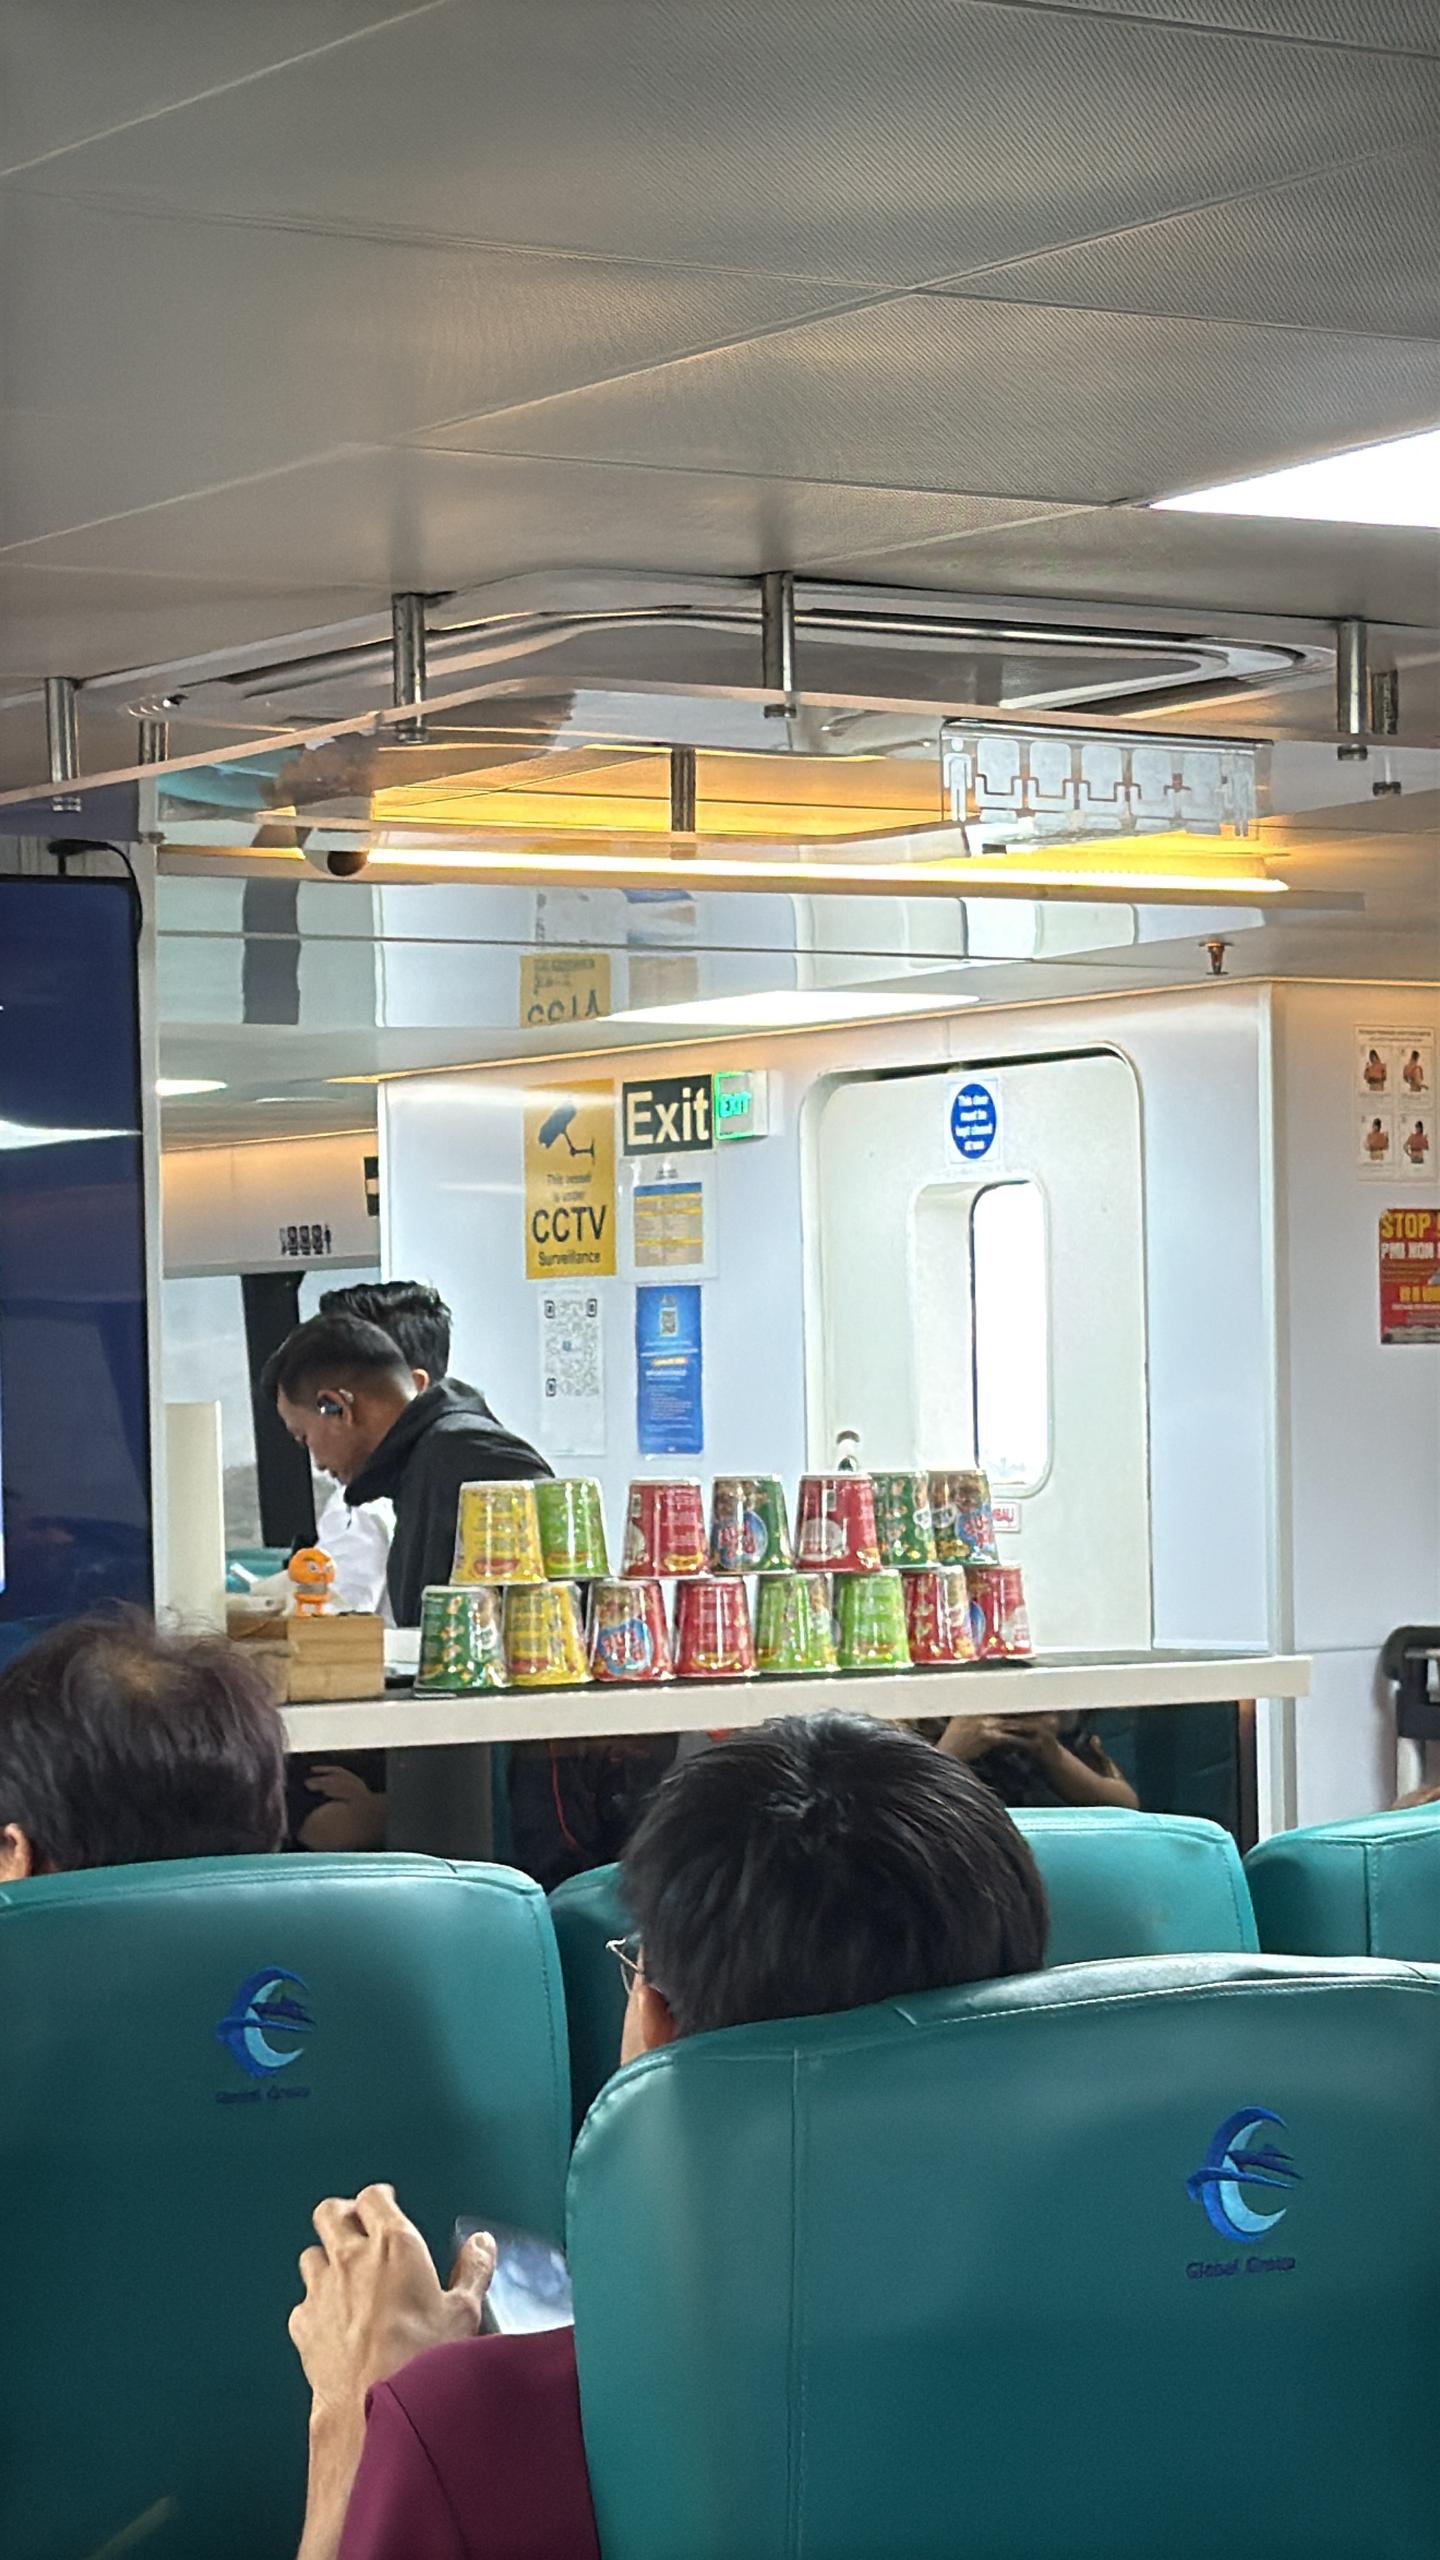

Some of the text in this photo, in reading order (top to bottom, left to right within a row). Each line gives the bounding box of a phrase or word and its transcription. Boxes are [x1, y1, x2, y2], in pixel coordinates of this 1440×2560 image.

[627, 1087, 709, 1145] Exit
[720, 1091, 752, 1117] EXIT
[532, 1205, 606, 1243] CCTV
[1381, 1213, 1431, 1239] STOP
[538, 1250, 601, 1267] Surveillance
